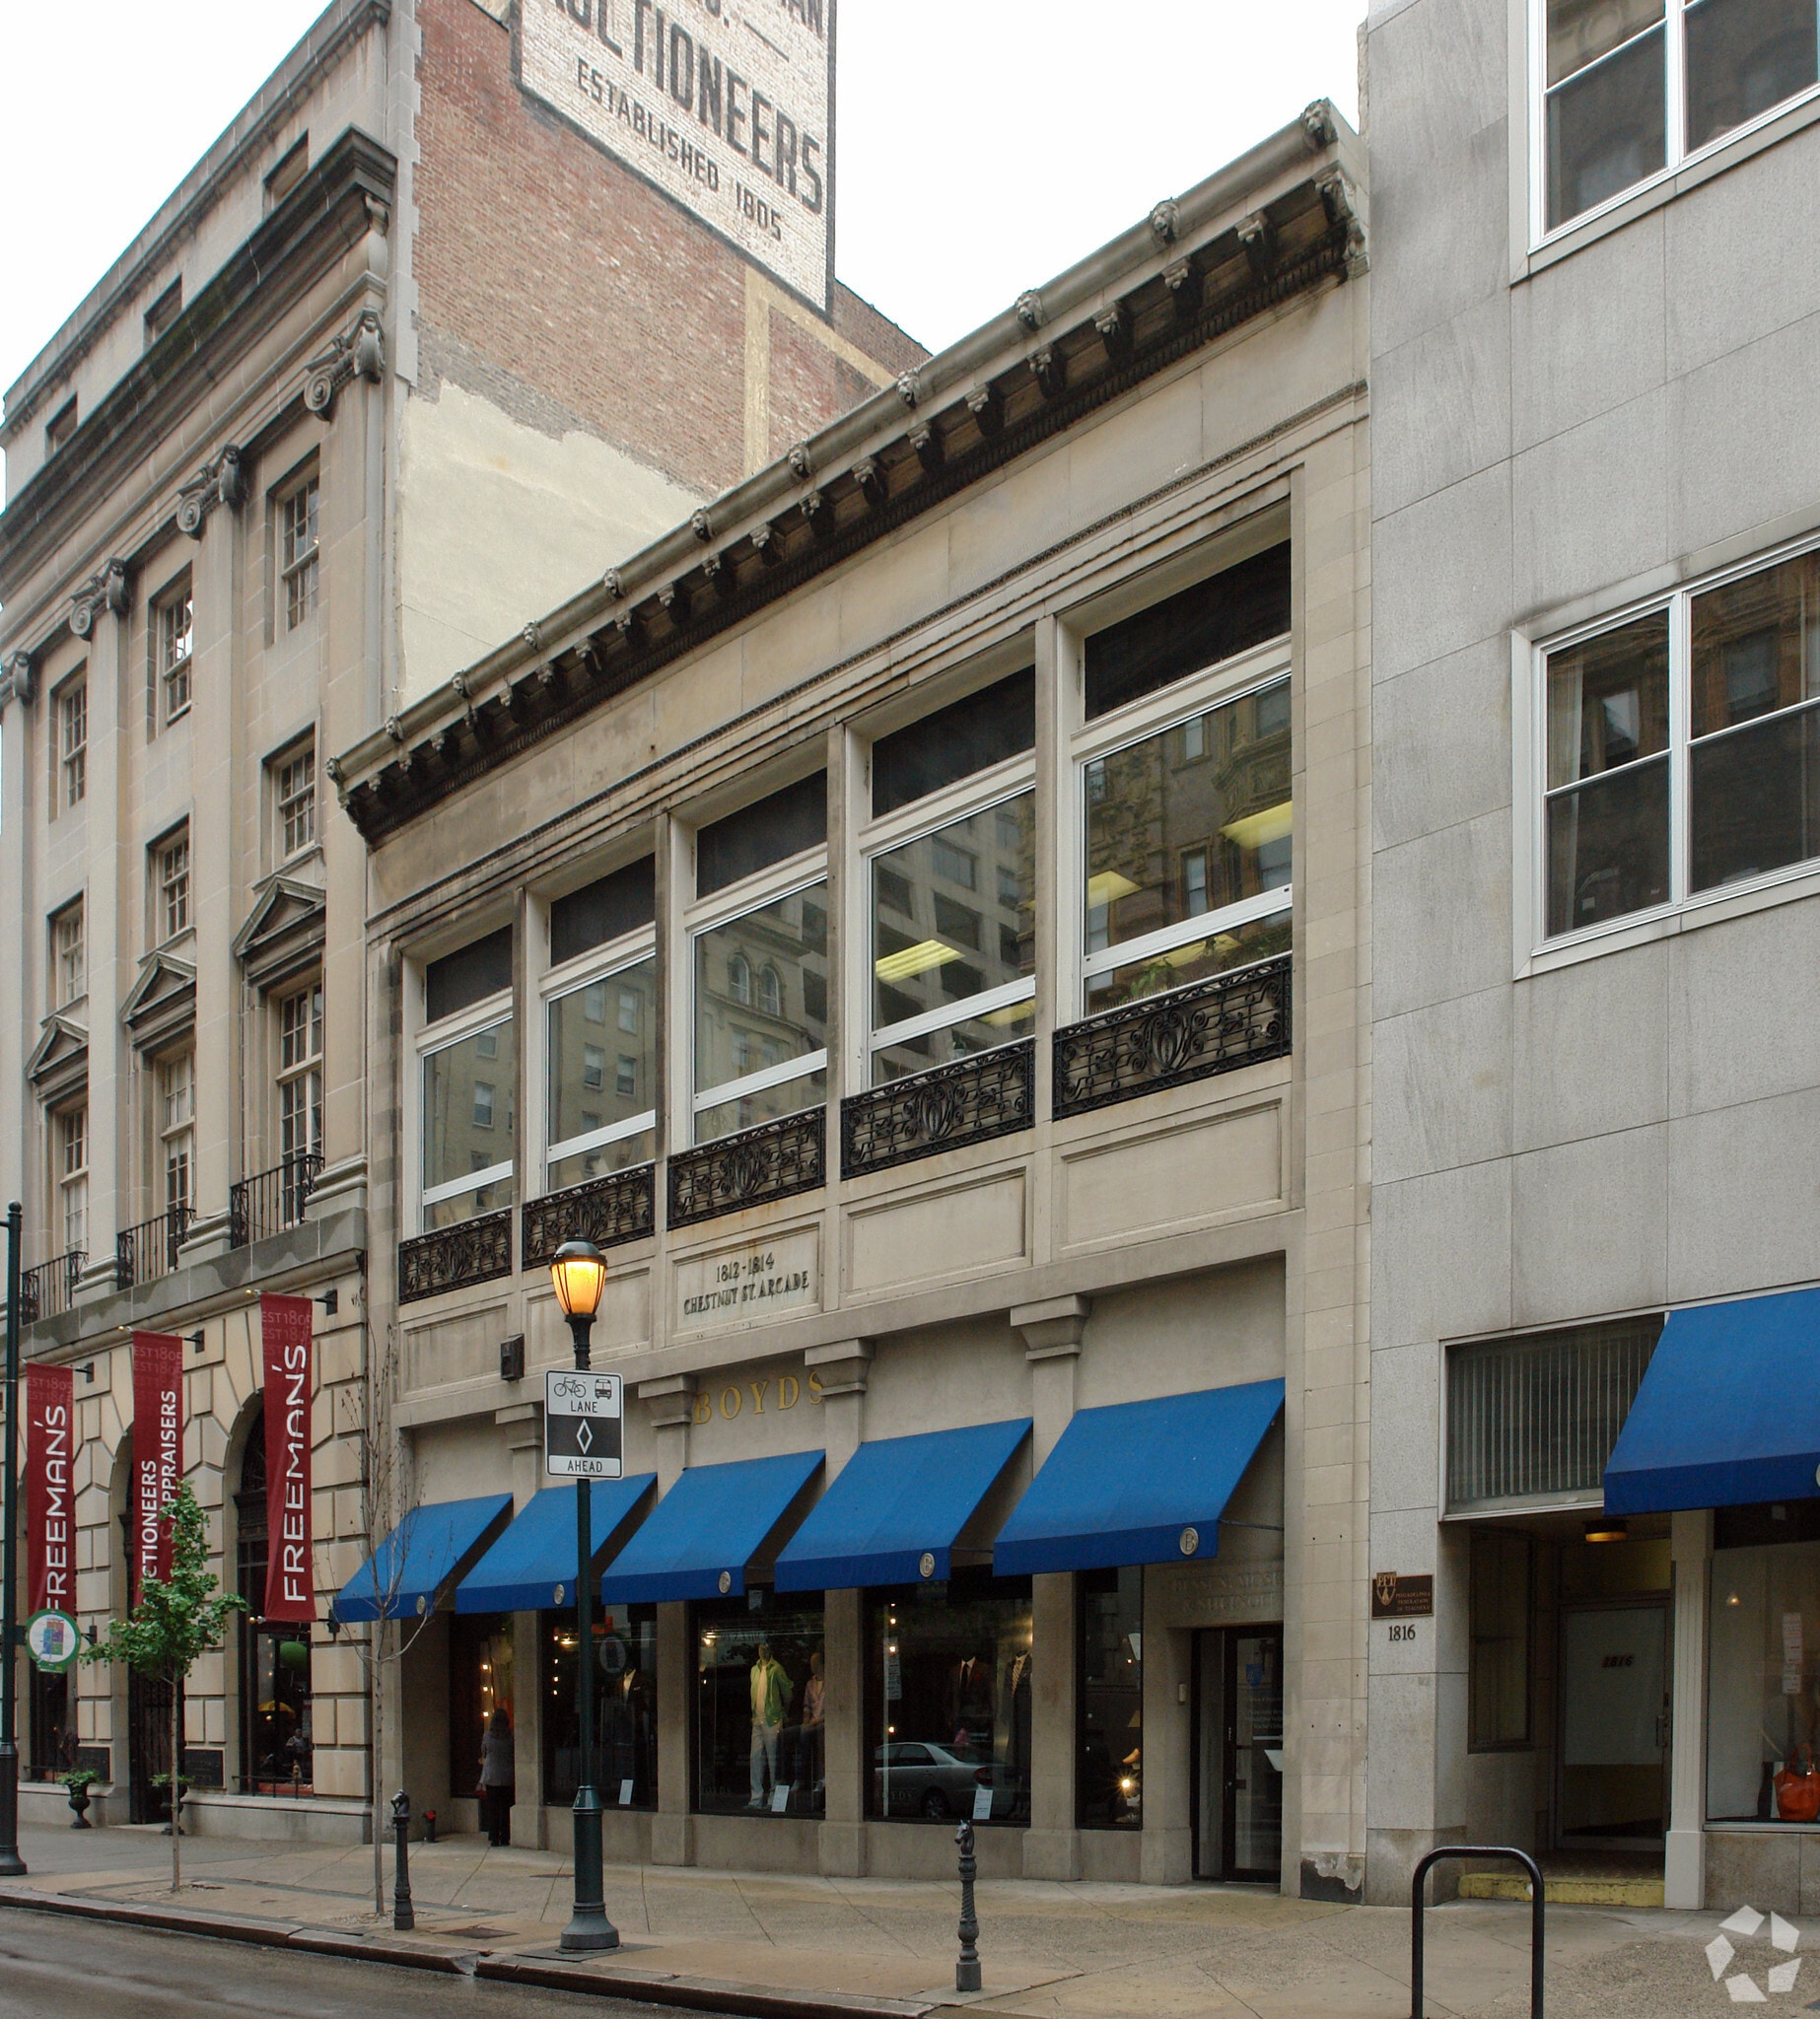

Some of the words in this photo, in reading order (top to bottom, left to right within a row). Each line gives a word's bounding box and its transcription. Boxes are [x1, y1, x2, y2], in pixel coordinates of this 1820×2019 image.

[554, 0, 822, 215] CTIONEERS
[577, 56, 720, 193] ESTABLISHED
[735, 181, 782, 243] 1805
[683, 1288, 738, 1315] CHESTNUT
[757, 1271, 809, 1298] ARCADE
[570, 1400, 598, 1414] LANE
[693, 1370, 823, 1426] BOYDS
[161, 1390, 176, 1519] PPRAISERS
[271, 1345, 308, 1602] FREEMAN'S
[567, 1460, 603, 1473] AHEAD
[141, 1460, 159, 1578] CTIONEERS
[1388, 1624, 1416, 1641] 1816
